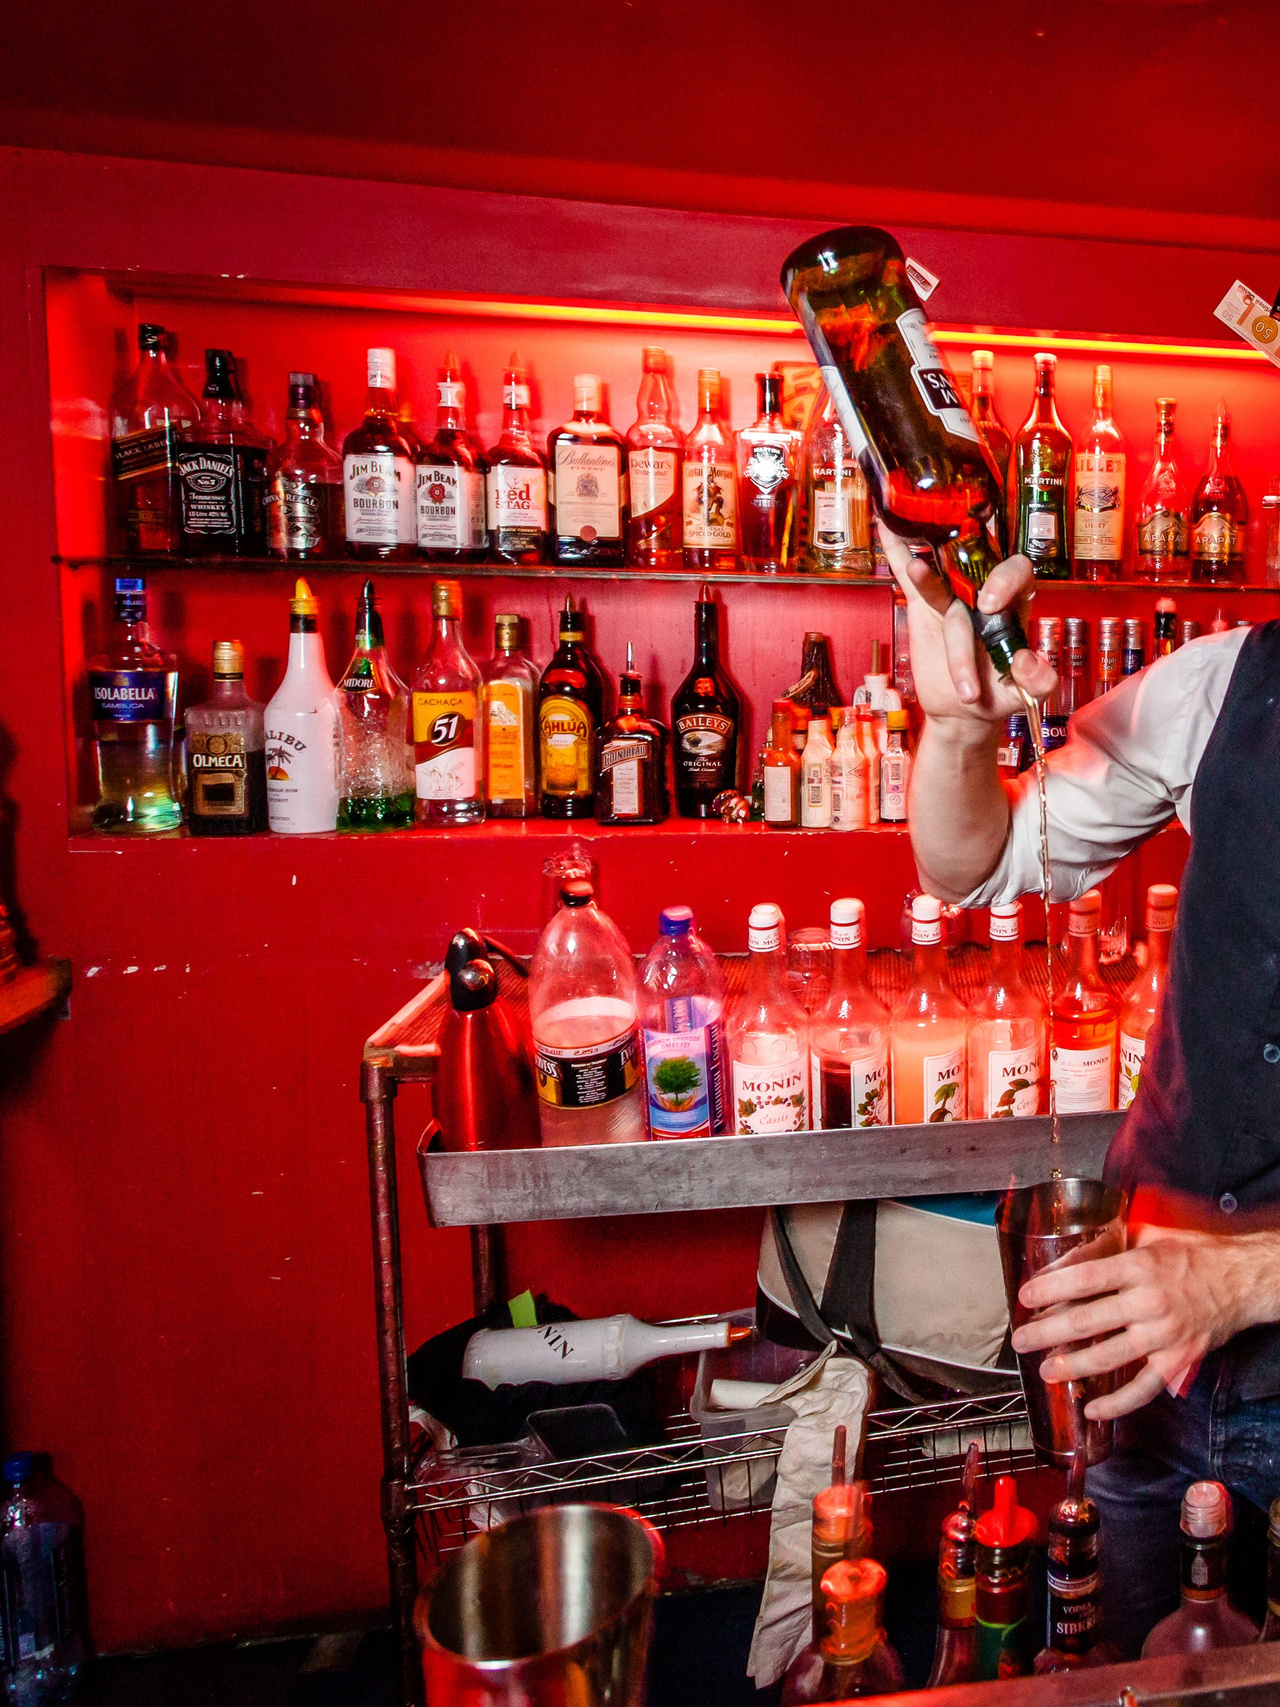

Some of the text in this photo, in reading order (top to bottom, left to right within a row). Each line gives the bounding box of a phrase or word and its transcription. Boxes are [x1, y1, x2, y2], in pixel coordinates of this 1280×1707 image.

[1255, 322, 1274, 339] 50
[557, 449, 616, 468] Ballantine's
[630, 458, 672, 469] Dewar's
[179, 456, 235, 479] JACK DANIEL'S
[350, 461, 402, 483] JIM BEM
[685, 466, 733, 479] Captai Morgan
[813, 467, 852, 477] MARTNI
[417, 464, 458, 489] JIM BEAM
[1024, 476, 1063, 486] MARTINI
[190, 503, 227, 511] WHISKEY
[285, 493, 317, 508] REGAL
[353, 497, 399, 510] BOURBON
[495, 501, 531, 510] STAG
[420, 505, 456, 516] BOURBON
[712, 530, 732, 539] GOLD
[344, 678, 375, 688] MIDORI
[94, 687, 155, 700] ISOLABELLA
[418, 698, 464, 706] CACHAÇA
[431, 715, 459, 744] 51
[679, 717, 729, 730] BAILEYS
[193, 754, 244, 768] OLMECA
[603, 744, 646, 768] COINTREAU
[1082, 1057, 1109, 1067] MONIN
[742, 1071, 802, 1093] MONIN
[759, 1113, 789, 1126] Cassis
[1063, 1601, 1093, 1615] VODKA
